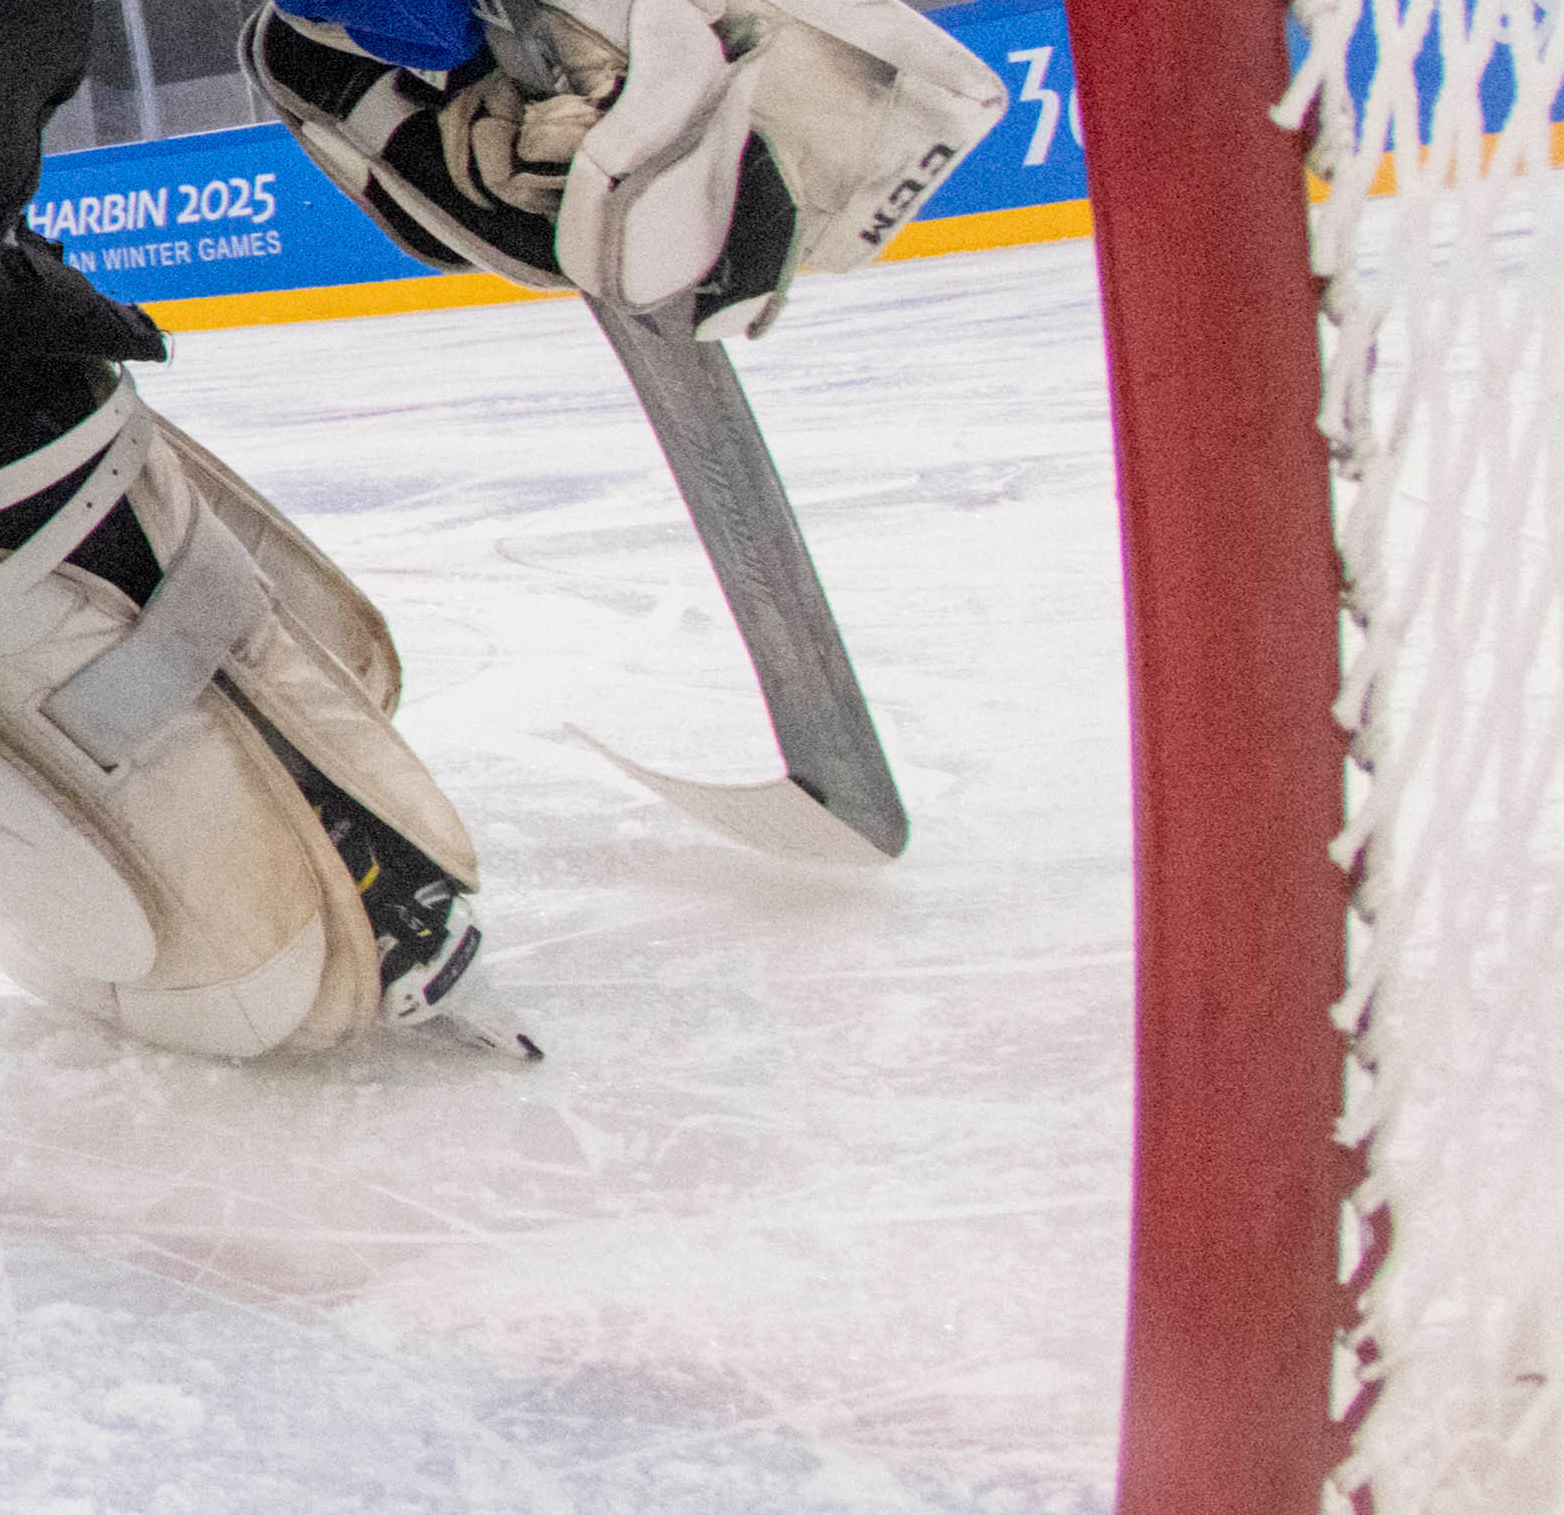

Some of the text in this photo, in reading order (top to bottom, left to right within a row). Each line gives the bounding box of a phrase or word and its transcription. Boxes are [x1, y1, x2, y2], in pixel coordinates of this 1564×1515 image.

[26, 173, 277, 239] HARBIN 2025
[859, 143, 958, 245] CCM
[102, 240, 192, 270] WINTER
[198, 230, 283, 262] GAMES
